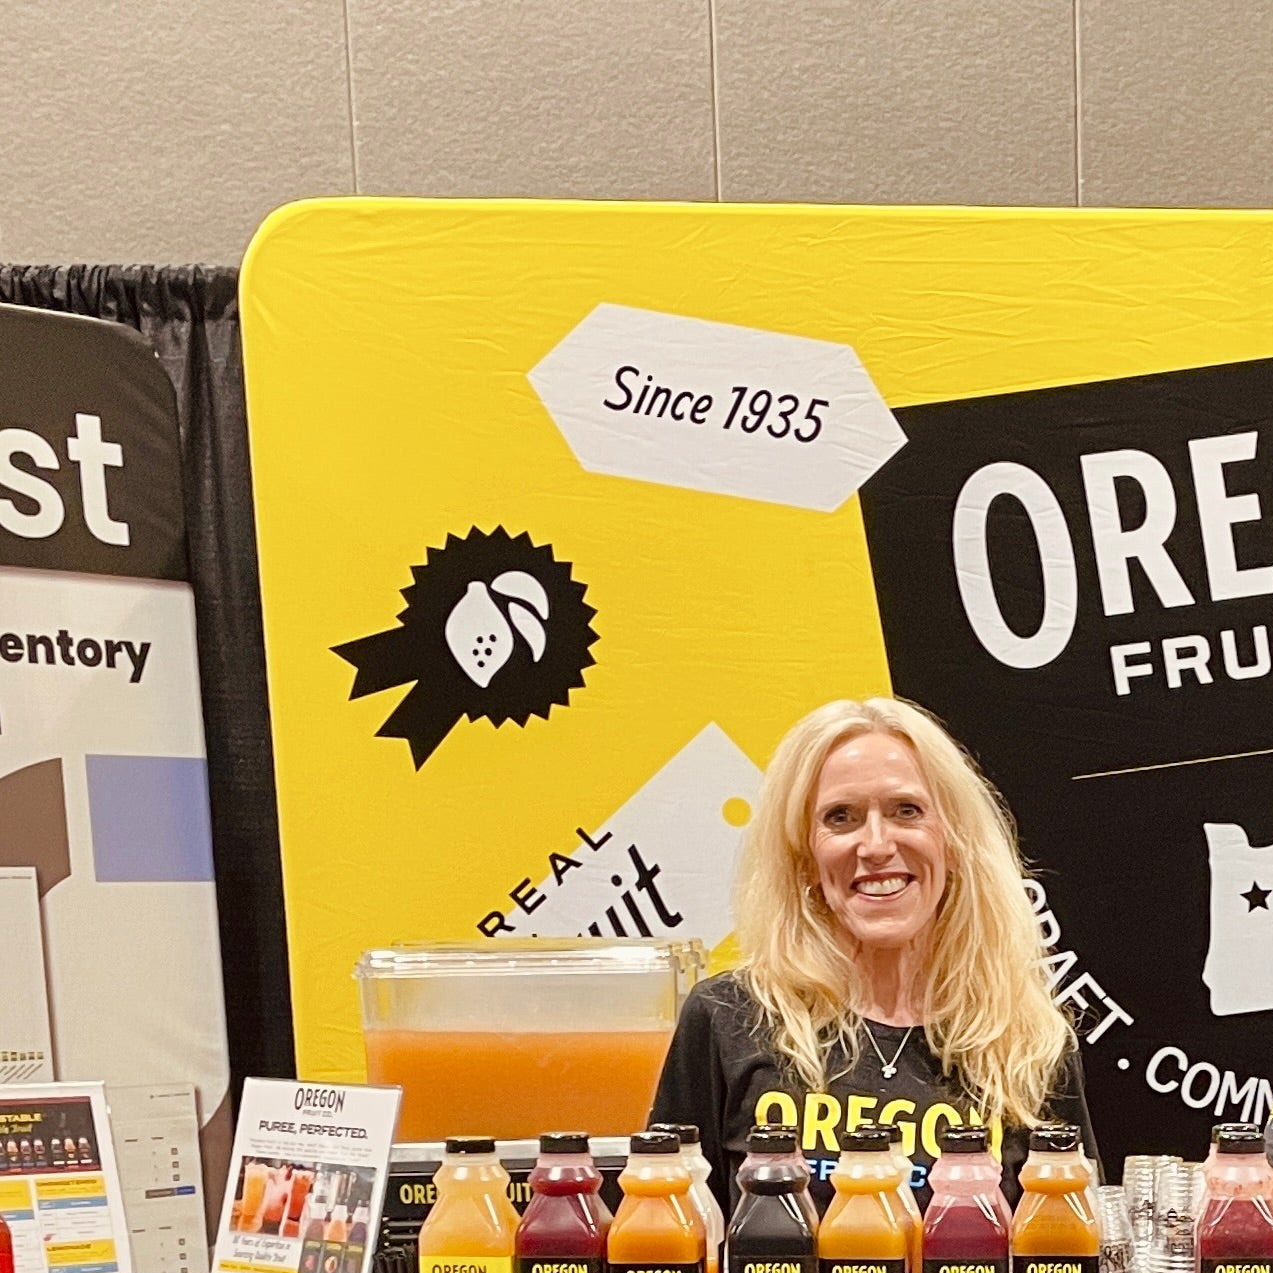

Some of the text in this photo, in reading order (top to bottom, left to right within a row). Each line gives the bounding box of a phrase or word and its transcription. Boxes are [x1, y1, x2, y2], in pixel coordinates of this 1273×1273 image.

[603, 365, 830, 443] Since 1935
[0, 630, 151, 684] entory
[476, 827, 613, 938] REAL
[294, 1087, 346, 1114] OREGON
[300, 1123, 369, 1140] PERFECTED.
[400, 1183, 438, 1205] ORE
